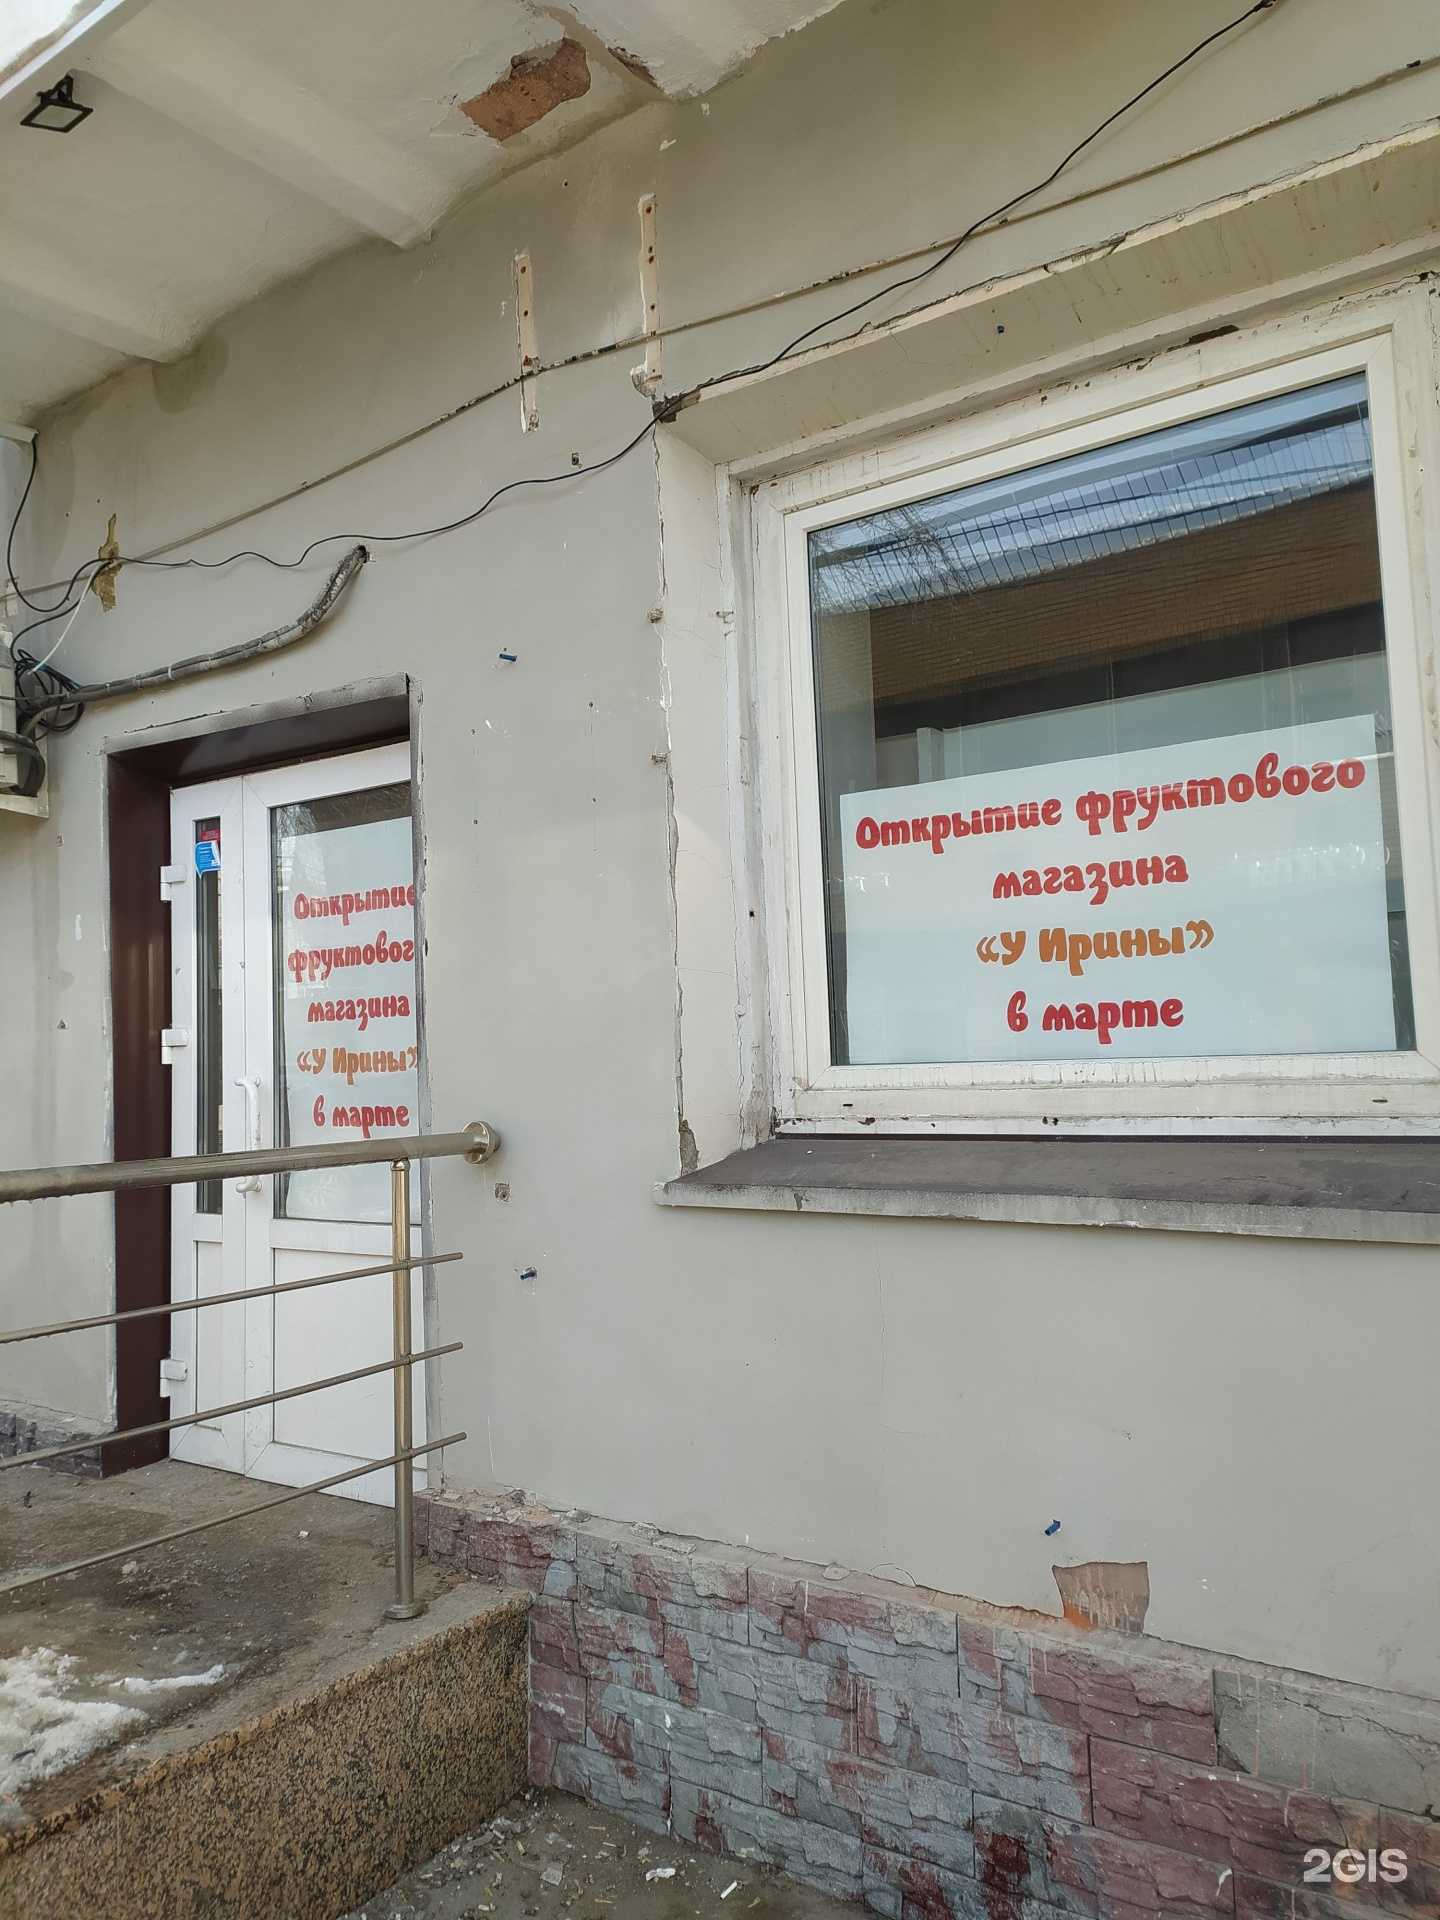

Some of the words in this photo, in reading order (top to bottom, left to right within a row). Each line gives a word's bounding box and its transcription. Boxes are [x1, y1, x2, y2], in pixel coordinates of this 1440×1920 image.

[855, 798, 1063, 855] Открытие
[1075, 752, 1367, 836] фруктового
[992, 854, 1189, 906] магазина
[287, 930, 415, 983] фруктовог
[976, 930, 1027, 966] «У
[1038, 919, 1215, 977] Ирины»
[307, 995, 411, 1031] магазина
[1007, 990, 1029, 1032] в
[1042, 998, 1184, 1045] марте
[313, 1094, 326, 1127] в
[332, 1105, 410, 1139] марте
